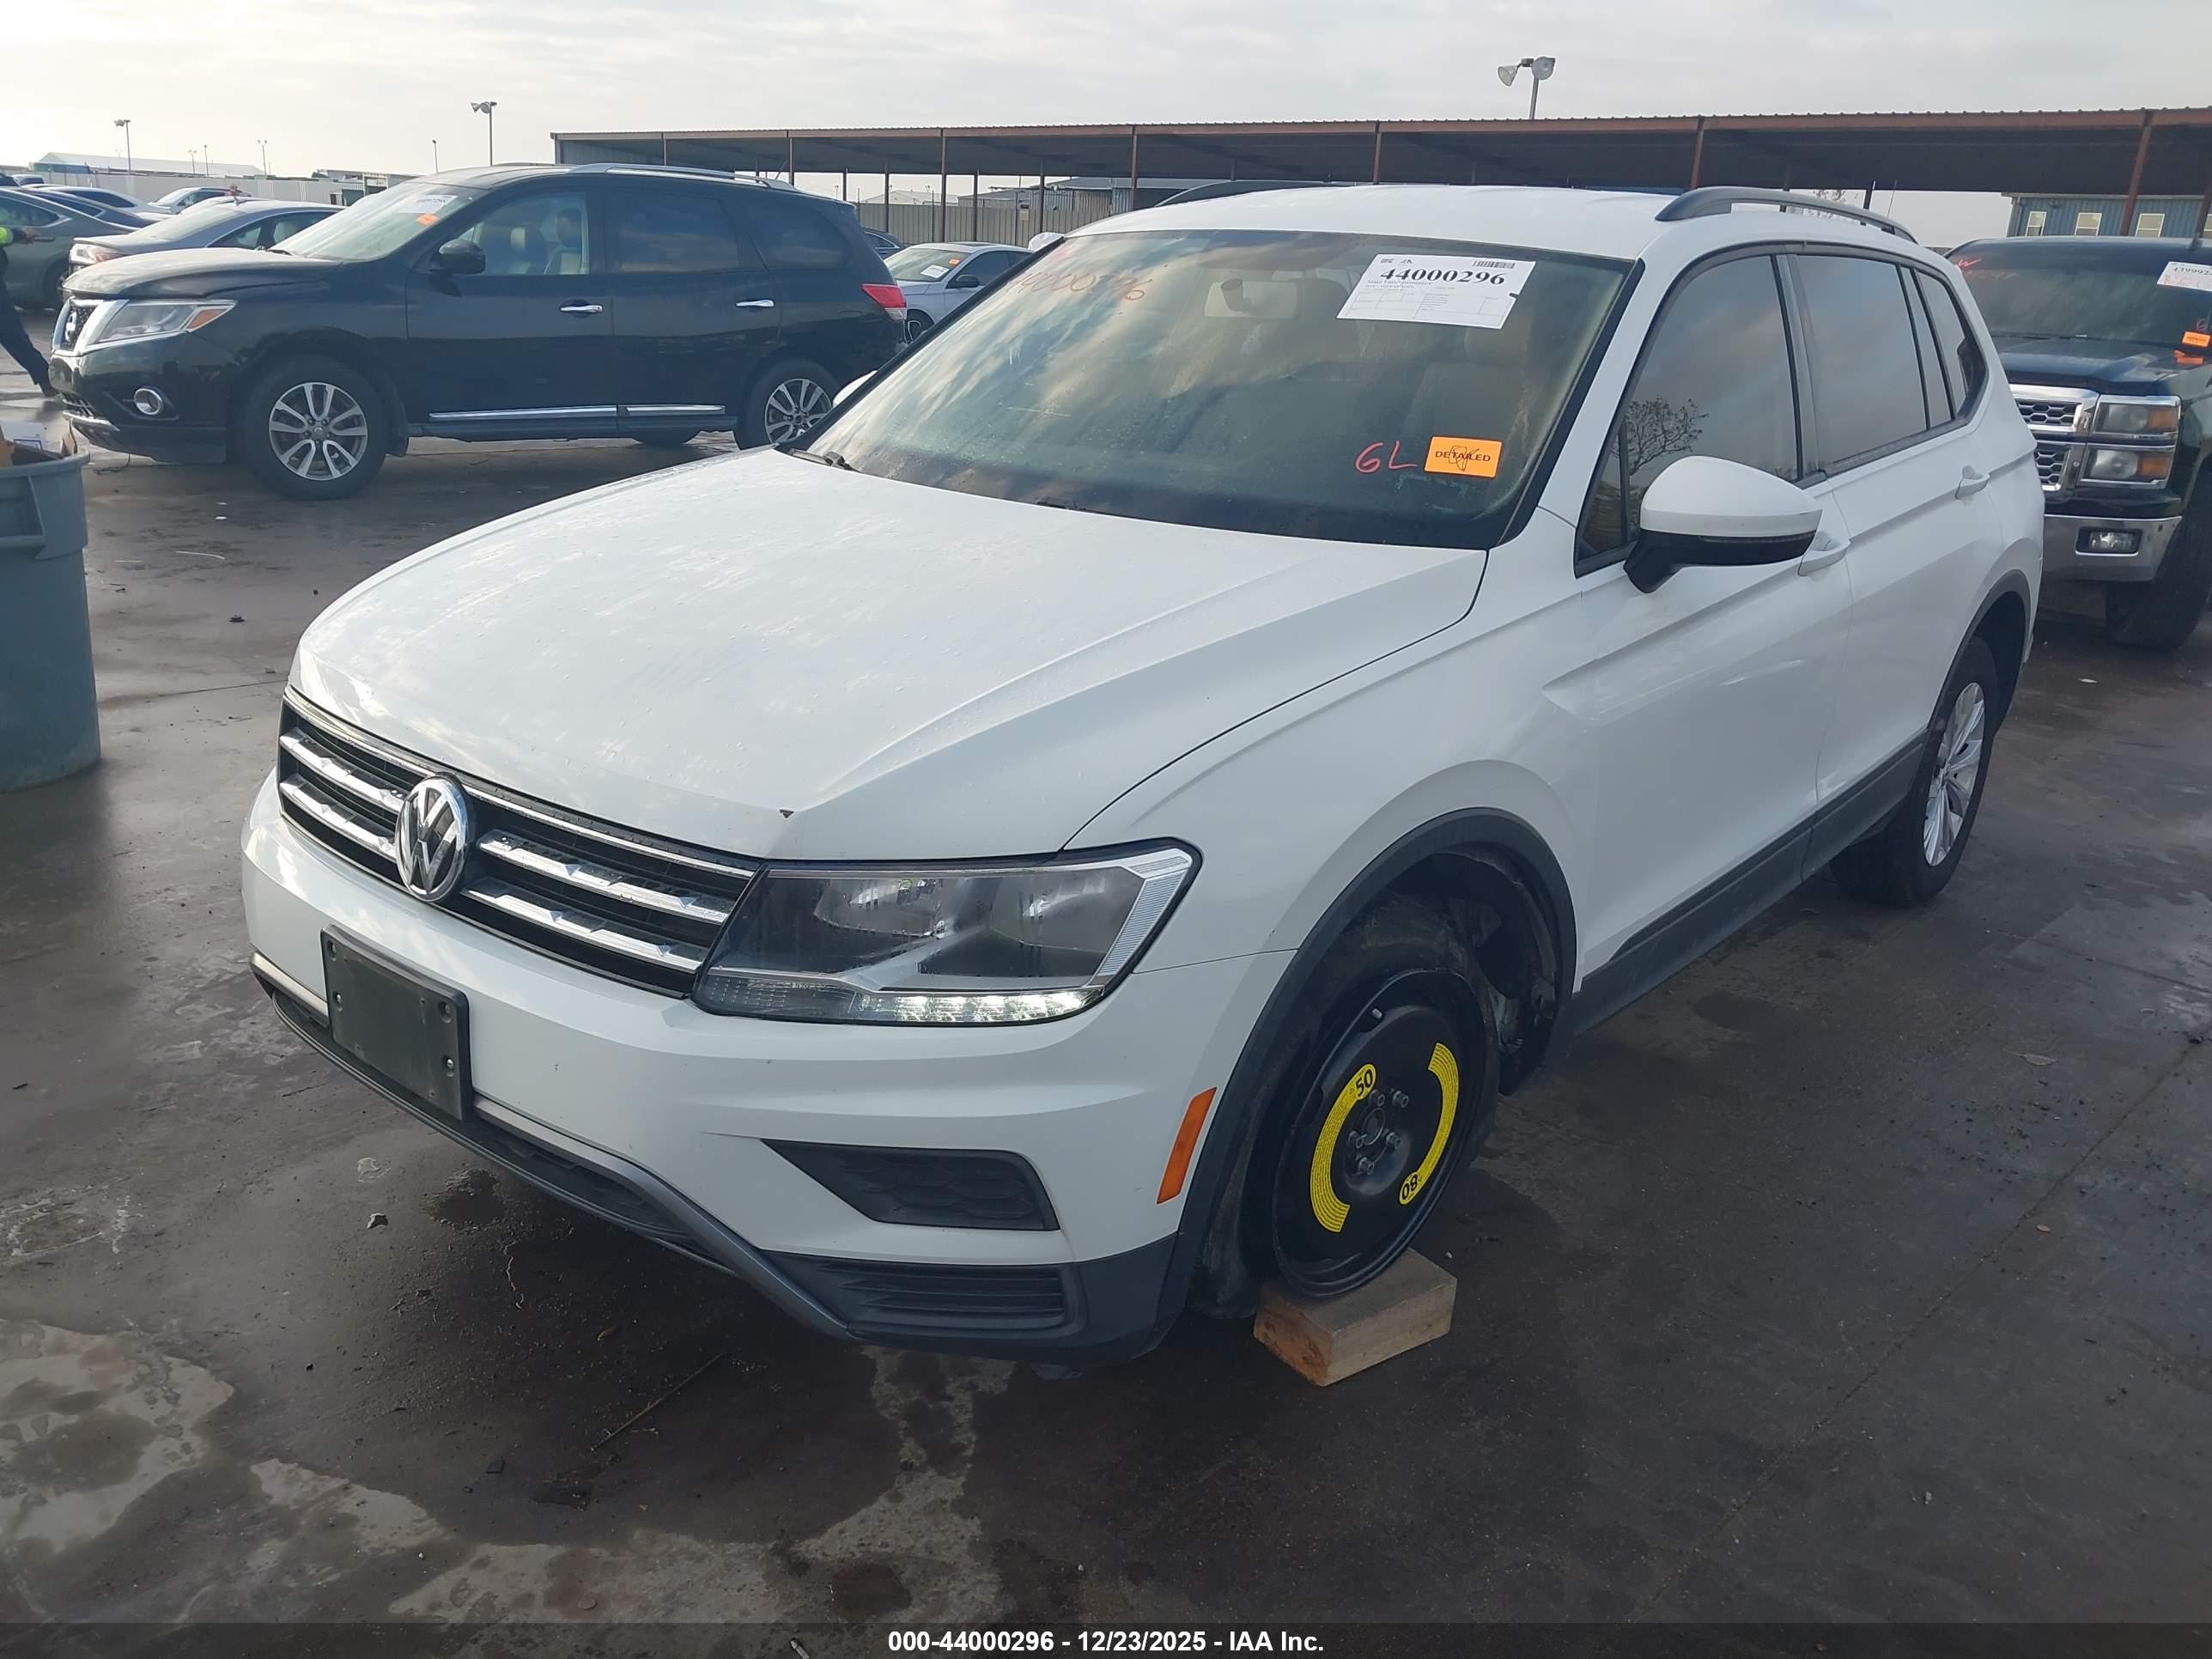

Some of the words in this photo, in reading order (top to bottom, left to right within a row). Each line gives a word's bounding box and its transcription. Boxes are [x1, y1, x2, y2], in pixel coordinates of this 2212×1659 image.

[1380, 268, 1505, 285] 44000296
[1435, 450, 1491, 462] DETAILED
[1355, 1069, 1373, 1097] 50
